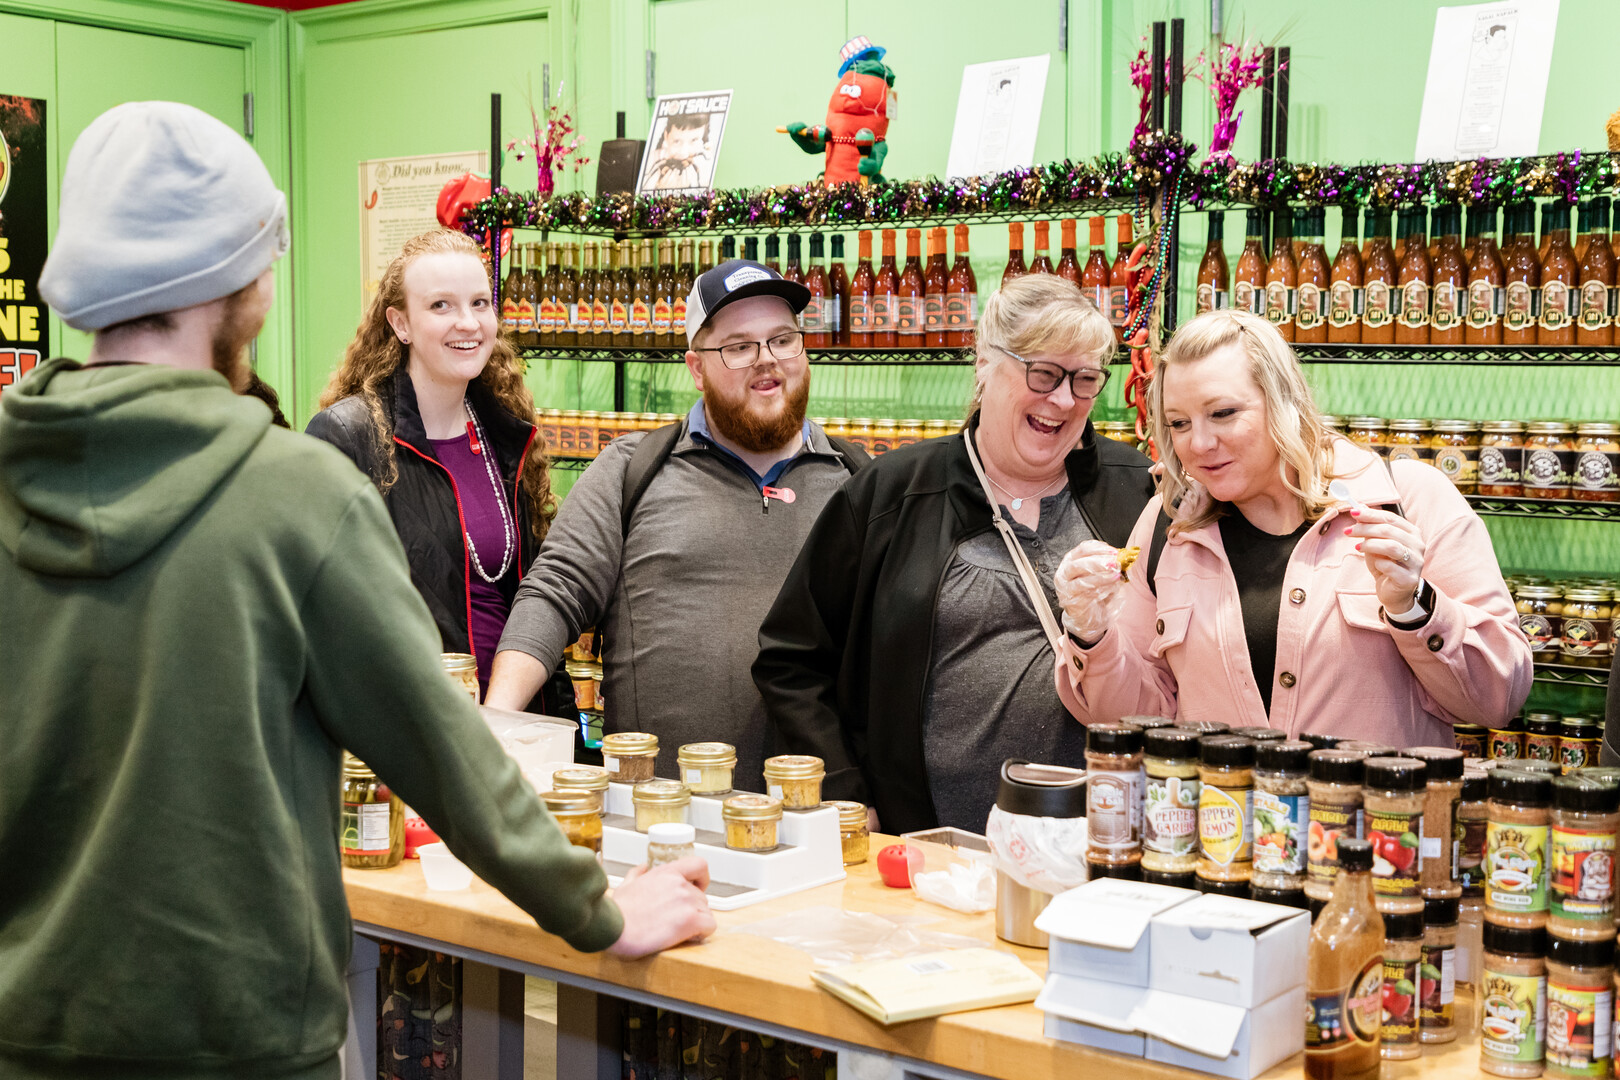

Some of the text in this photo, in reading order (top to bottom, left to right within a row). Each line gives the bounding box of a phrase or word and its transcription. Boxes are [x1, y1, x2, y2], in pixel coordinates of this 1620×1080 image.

[658, 96, 730, 116] HOT SAUCE
[392, 164, 412, 178] Did
[412, 164, 432, 181] you
[0, 278, 26, 300] HE
[0, 305, 40, 341] NE
[1155, 809, 1196, 822] PEPPER
[1200, 807, 1236, 822] EPPER
[1156, 822, 1196, 833] GARLIC
[1200, 820, 1236, 836] LEMON
[1371, 818, 1410, 833] APPLE
